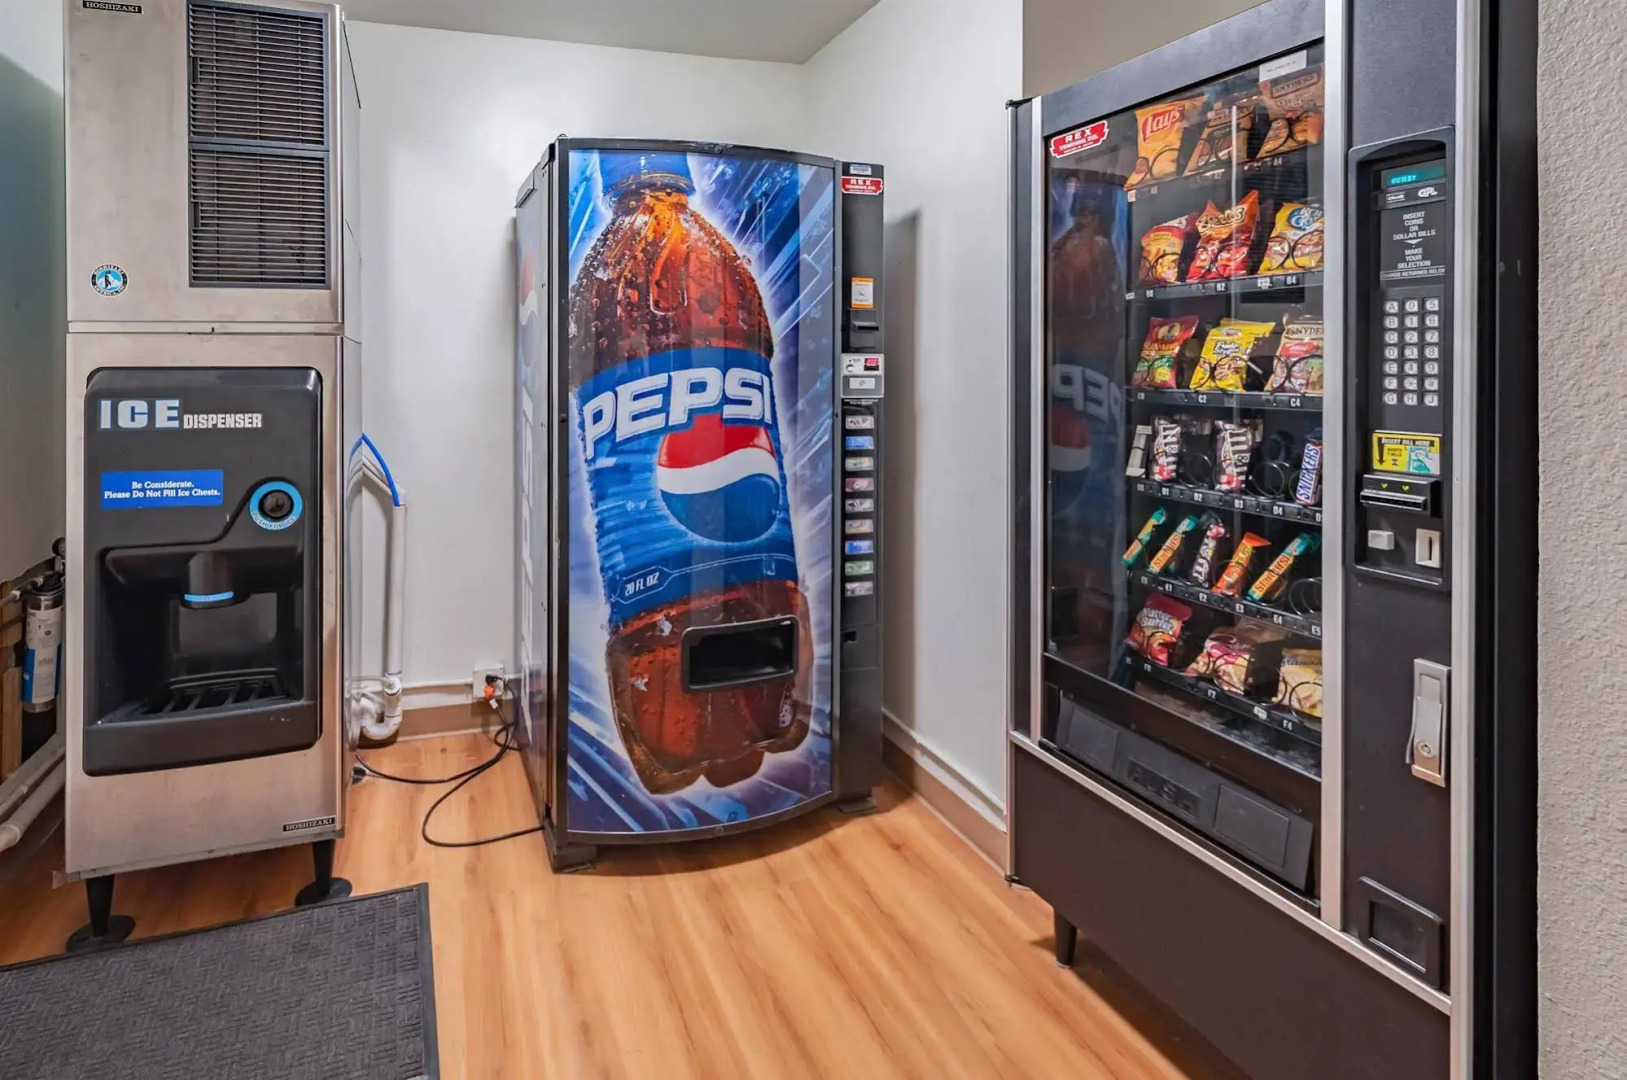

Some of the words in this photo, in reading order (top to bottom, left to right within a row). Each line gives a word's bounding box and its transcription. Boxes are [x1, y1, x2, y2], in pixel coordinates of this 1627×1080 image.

[86, 2, 139, 12] HOSHIZAKI
[1065, 128, 1092, 143] REX
[1417, 186, 1439, 198] GPL
[1403, 211, 1425, 220] INSERT
[1404, 218, 1424, 226] COINS
[1392, 231, 1417, 240] DOLLAR
[1418, 229, 1436, 237] BILLS
[1397, 260, 1431, 269] SELECTION
[1286, 276, 1297, 285] B4
[1217, 283, 1225, 291] B2
[1198, 394, 1207, 403] C2
[1290, 398, 1301, 407] C4
[100, 399, 180, 429] ICE
[183, 413, 262, 429] DISPENSER
[583, 367, 772, 461] PEPSI
[1297, 443, 1321, 500] SNICKERS
[131, 481, 142, 489] Be
[144, 481, 195, 489] Considerate.
[104, 490, 130, 499] Please
[132, 490, 144, 498] Do
[146, 489, 161, 498] Not
[163, 489, 176, 497] Fill
[178, 488, 190, 497] Ice
[191, 488, 220, 496] Chests.
[625, 581, 635, 597] 20
[636, 578, 646, 591] FL
[646, 571, 660, 587] OZ
[1165, 583, 1173, 592] E1
[1199, 593, 1207, 602] E2
[1235, 604, 1244, 613] E3
[1273, 614, 1283, 625] E4
[1311, 625, 1321, 635] E5
[1207, 689, 1216, 699] F2
[1283, 720, 1292, 731] F4
[286, 818, 333, 831] HOSHIZAKI
